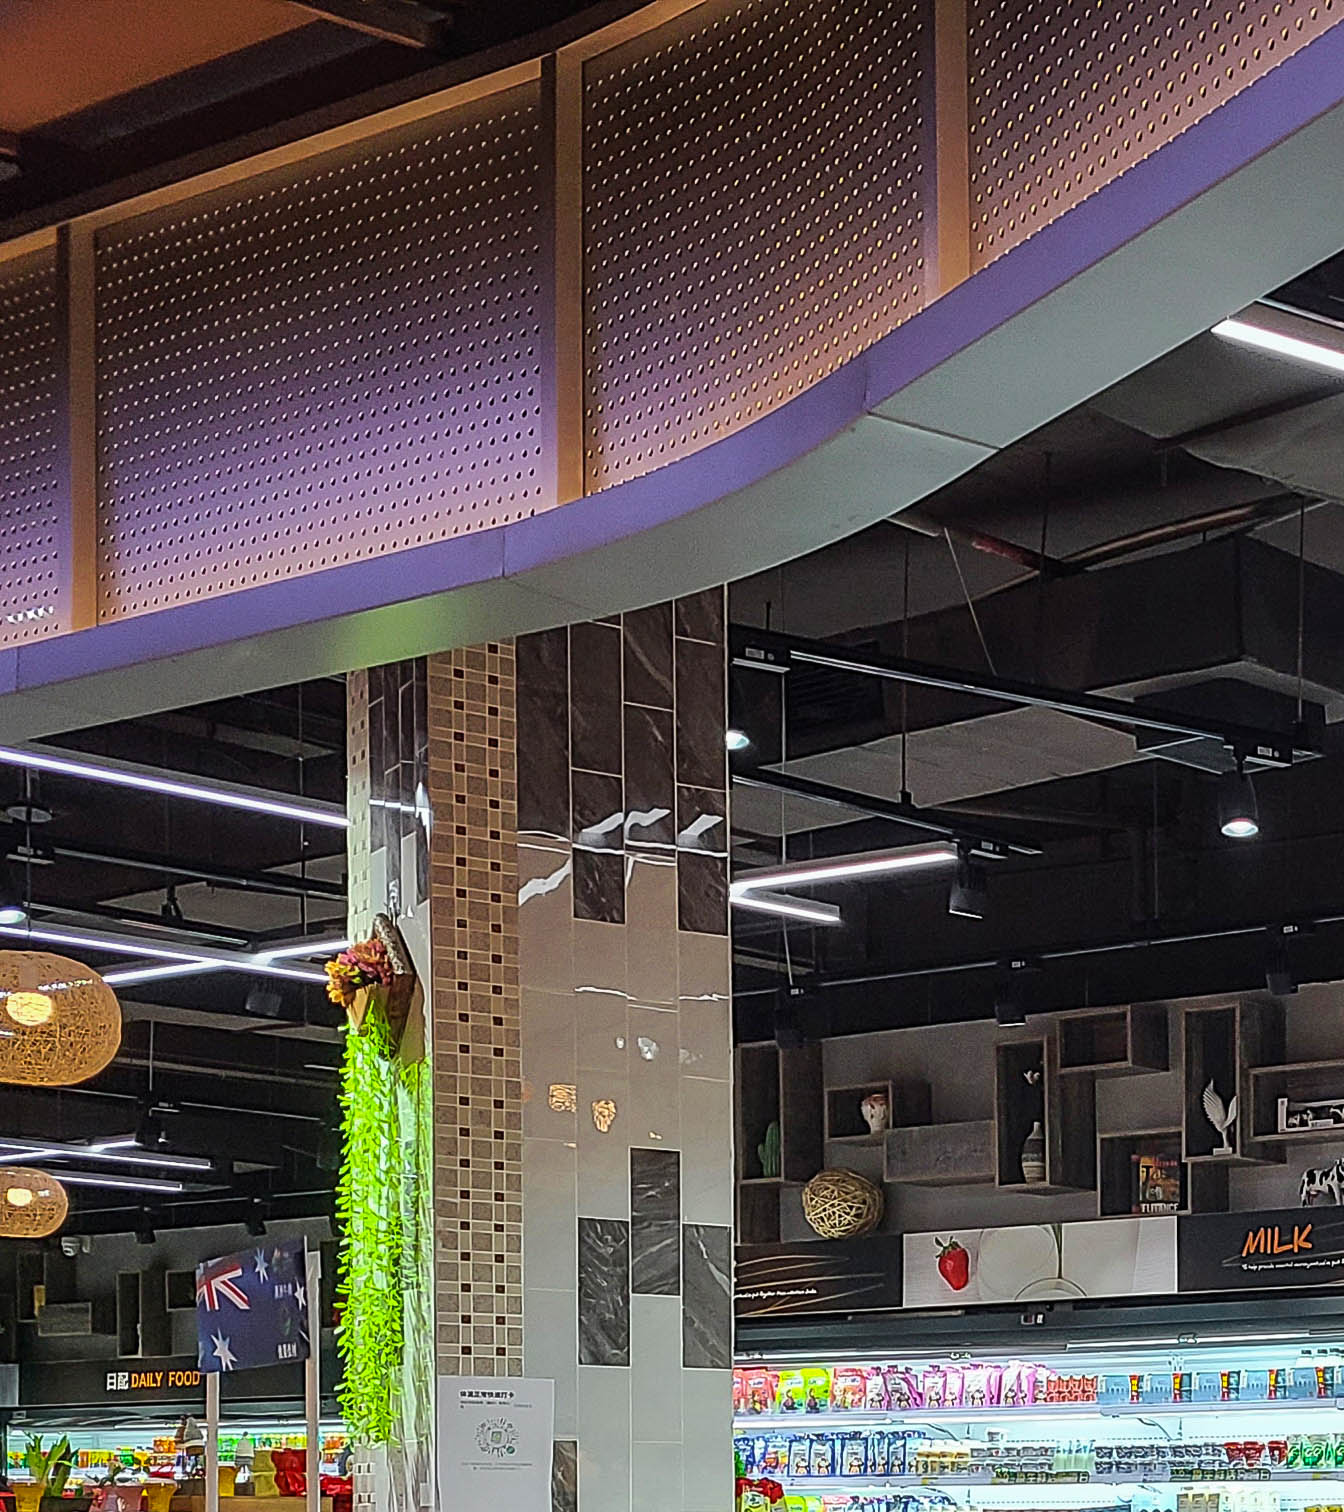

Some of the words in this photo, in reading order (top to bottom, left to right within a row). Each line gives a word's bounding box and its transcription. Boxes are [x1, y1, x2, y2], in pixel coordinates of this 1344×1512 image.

[1241, 1223, 1313, 1257] MILK
[106, 1372, 129, 1391] 日配
[131, 1372, 164, 1389] DAILY
[168, 1370, 200, 1387] FOOD
